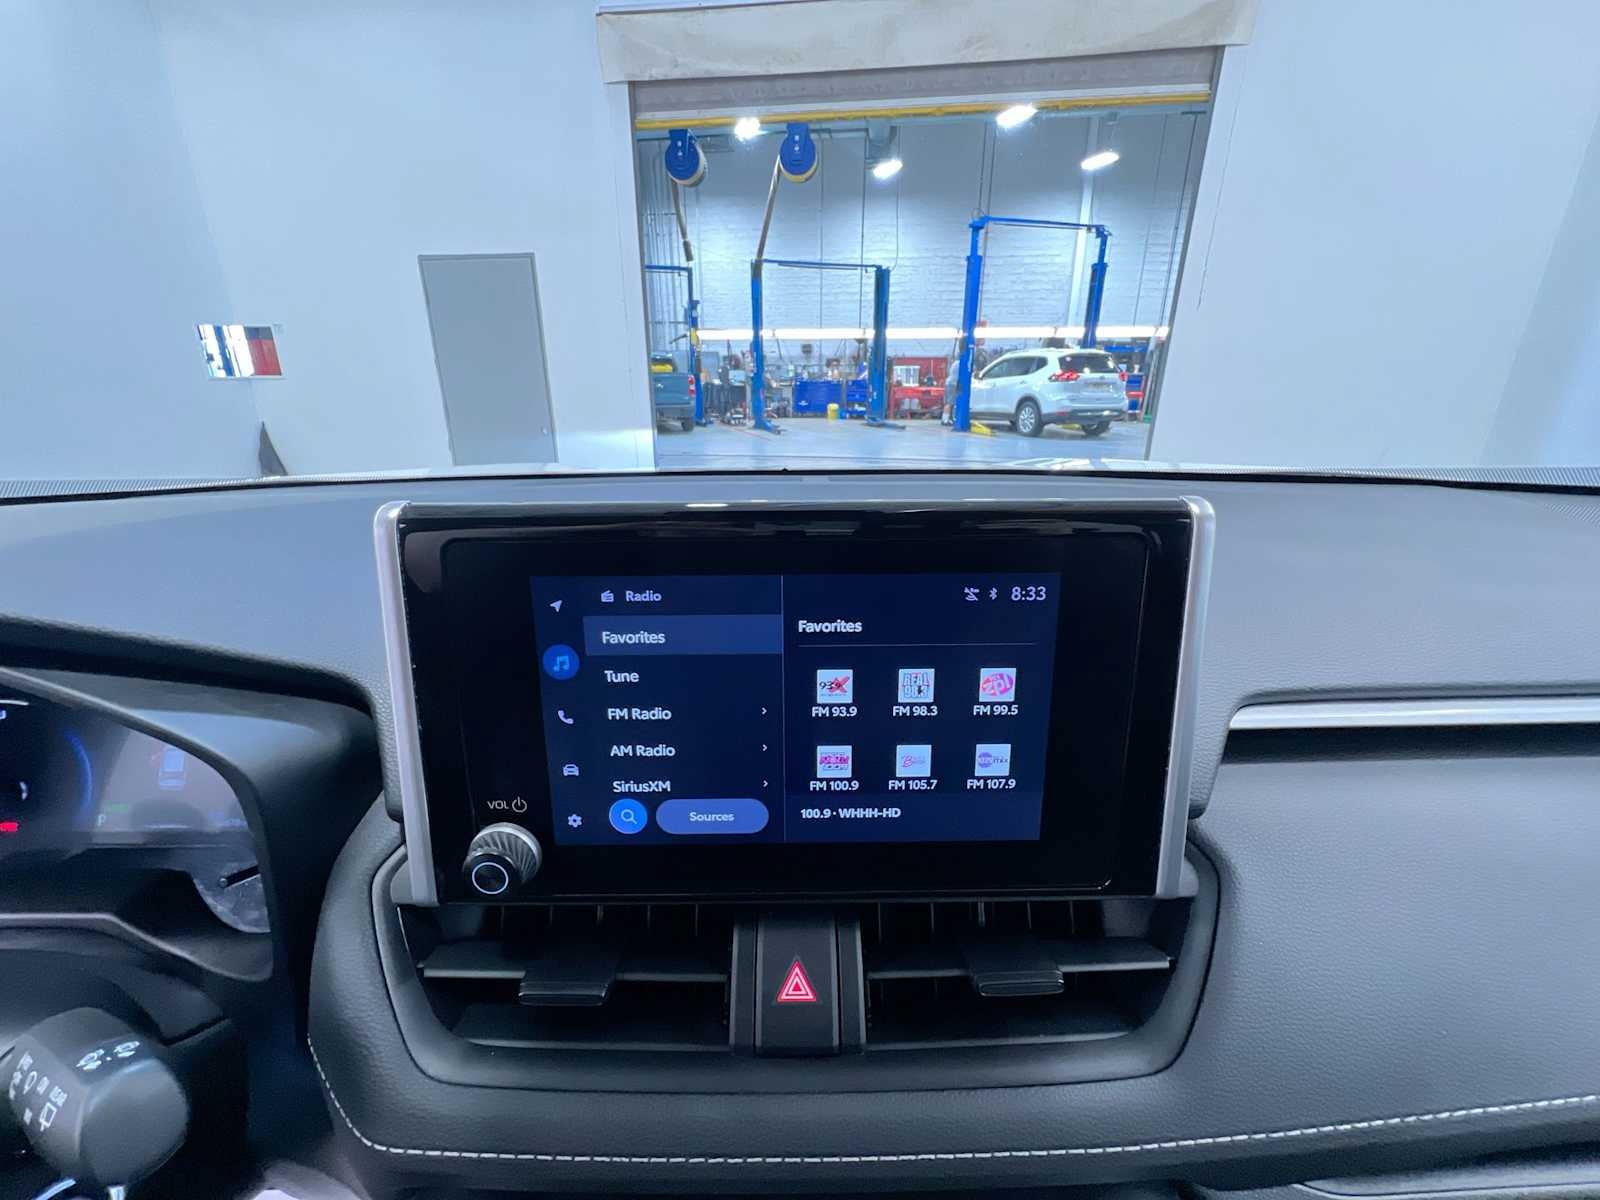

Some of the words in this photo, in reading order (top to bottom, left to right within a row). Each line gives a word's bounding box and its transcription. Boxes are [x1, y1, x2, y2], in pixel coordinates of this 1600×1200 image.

[625, 590, 662, 603] Radio
[1010, 586, 1047, 601] 8:33
[798, 620, 863, 633] Favorites
[601, 631, 666, 644] Favorites
[604, 670, 640, 683] Tune
[607, 708, 629, 721] FM
[631, 707, 673, 721] Radio
[811, 706, 830, 718] FM
[831, 706, 858, 718] 93.9
[892, 706, 910, 717] FM
[912, 705, 938, 717] 98.3
[973, 705, 992, 716] FM
[993, 704, 1019, 716] 99.5
[610, 744, 633, 757] AM
[636, 744, 676, 757] Radio
[612, 780, 671, 793] SiriusXM
[809, 780, 828, 791] FM
[829, 780, 859, 791] 100.9
[888, 779, 906, 790] FM
[908, 779, 938, 790] 105.7
[966, 779, 985, 790] FM
[986, 778, 1016, 790] 107.9
[487, 800, 509, 810] VOL
[689, 811, 735, 823] Sources
[800, 808, 832, 819] 100.9
[838, 807, 902, 818] WHHH-HD
